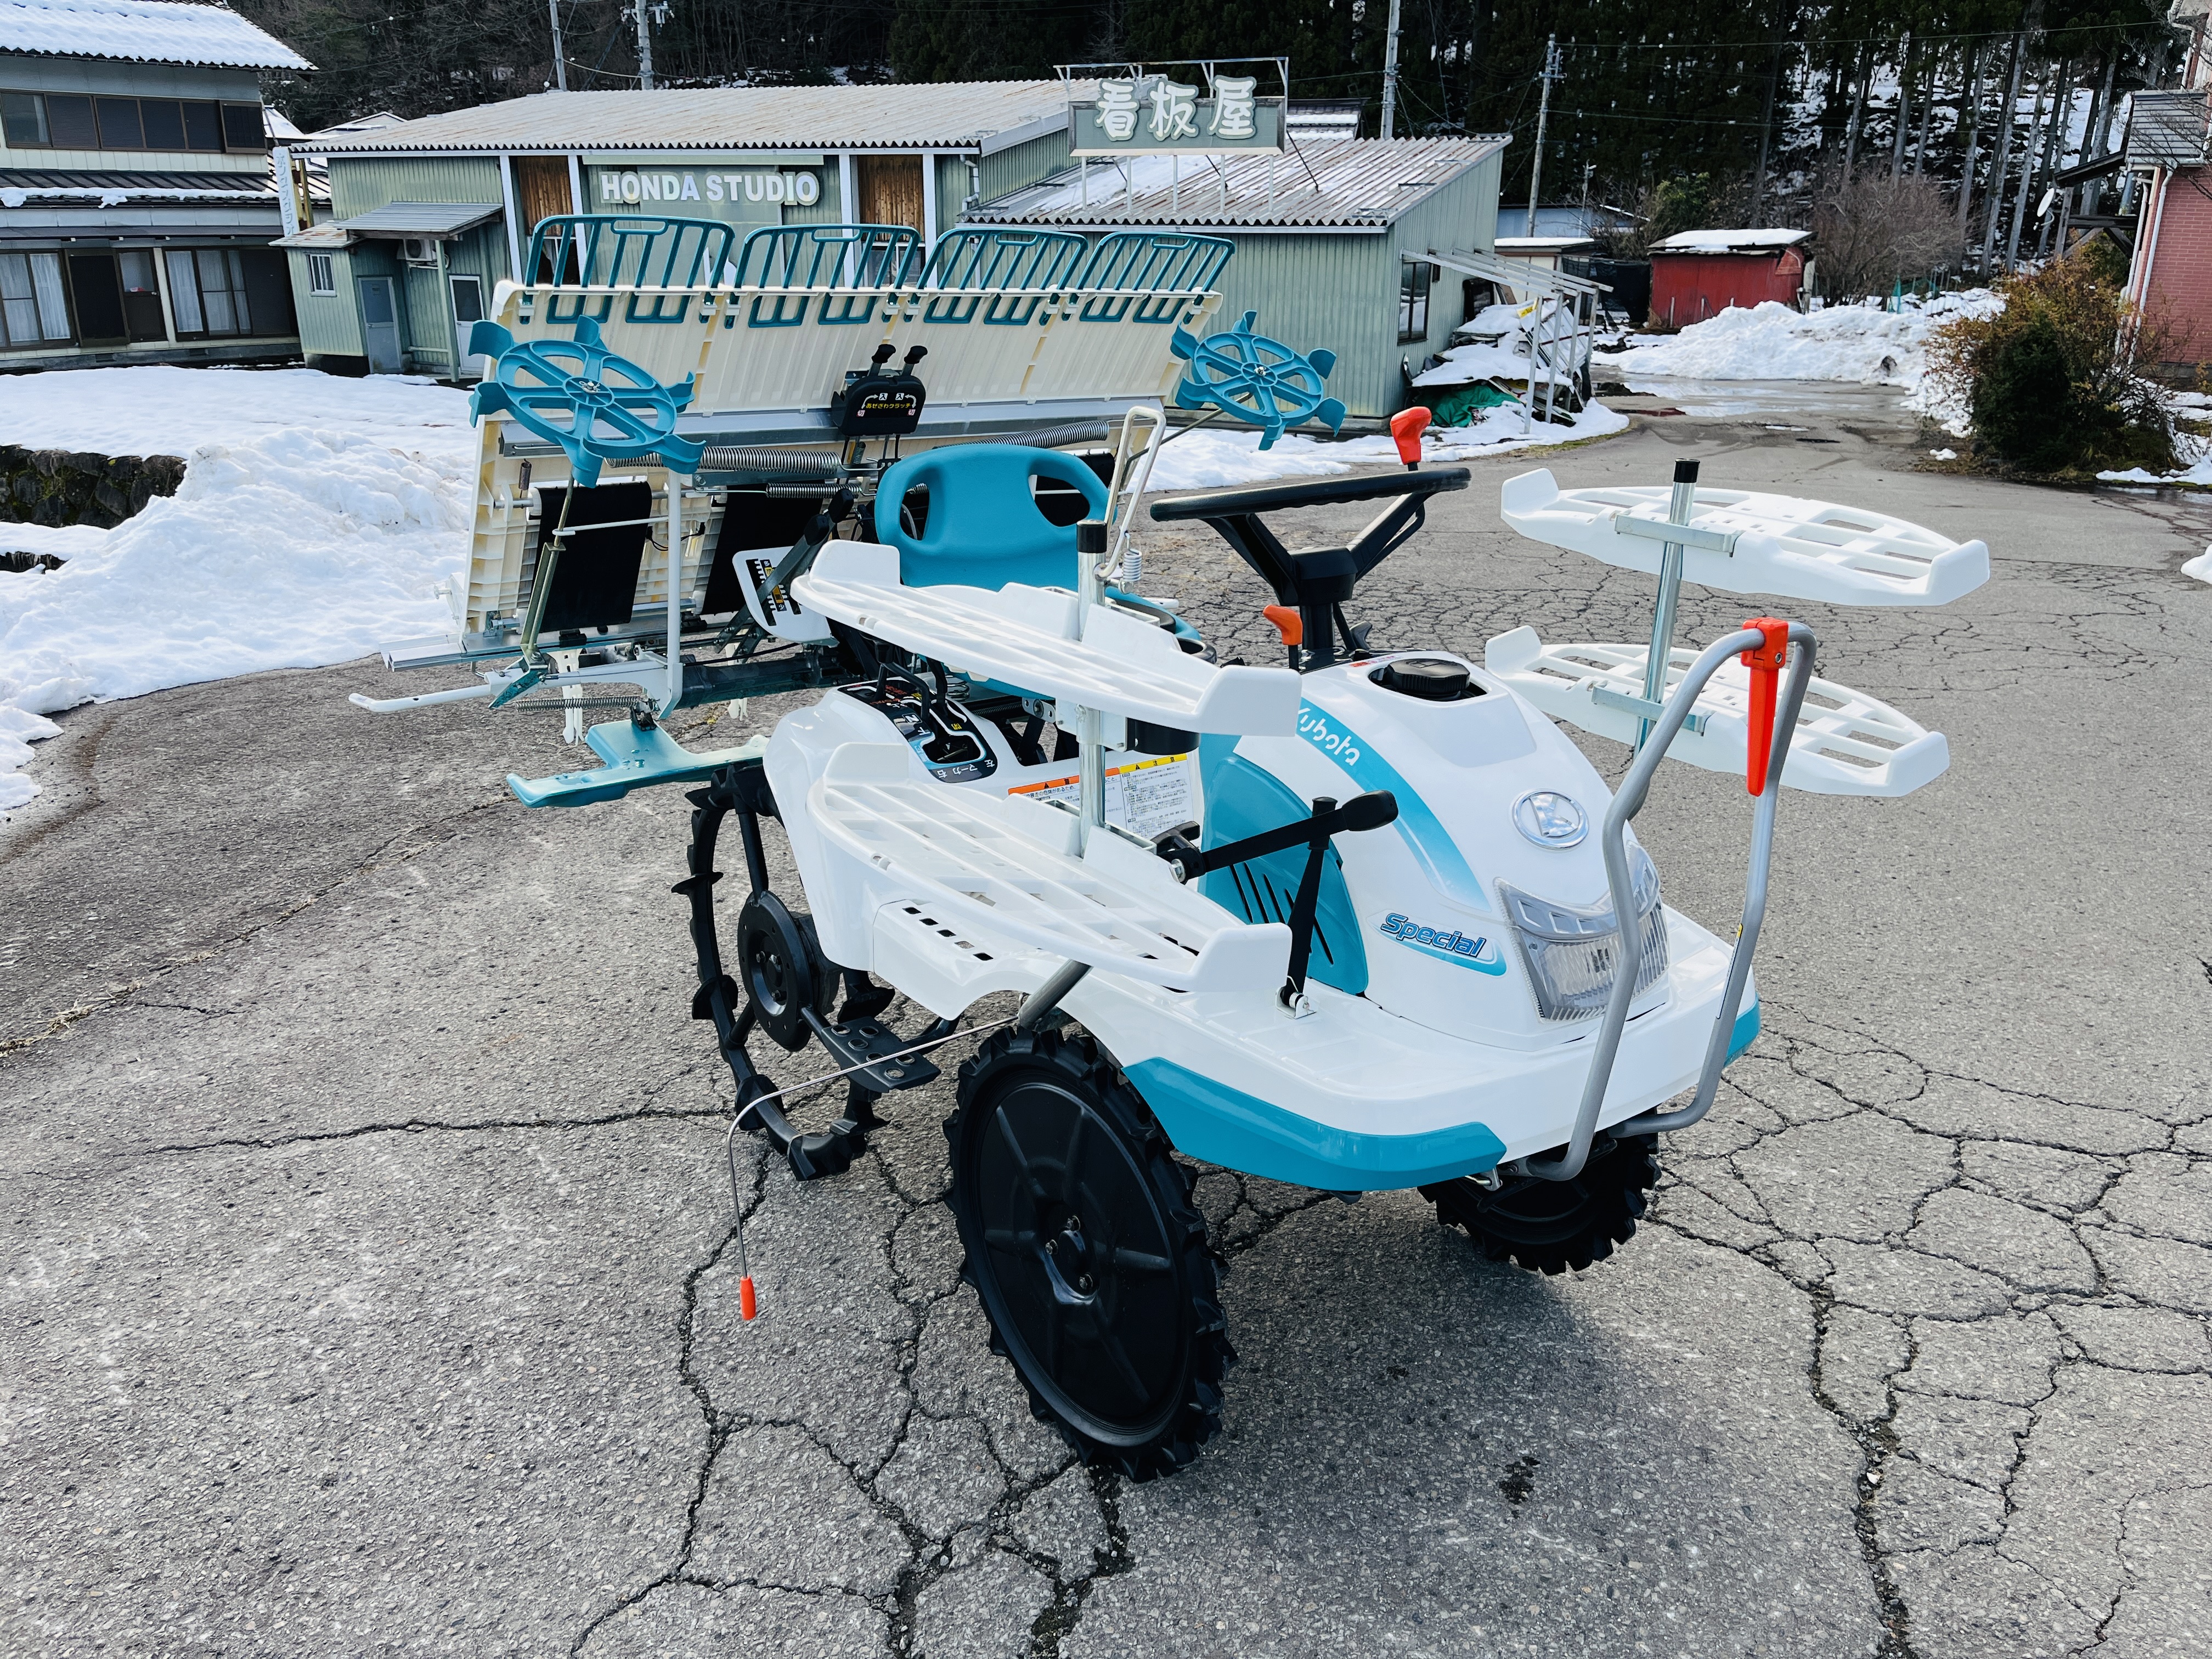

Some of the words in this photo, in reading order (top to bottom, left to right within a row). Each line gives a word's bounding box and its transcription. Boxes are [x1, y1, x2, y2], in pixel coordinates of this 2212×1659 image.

[1096, 79, 1255, 138] 看板屋
[601, 174, 701, 201] HONDA
[706, 174, 817, 202] STUDIO
[952, 764, 978, 775] マーカ
[984, 759, 995, 768] 左
[936, 770, 947, 778] 右
[1380, 912, 1487, 958] Special
